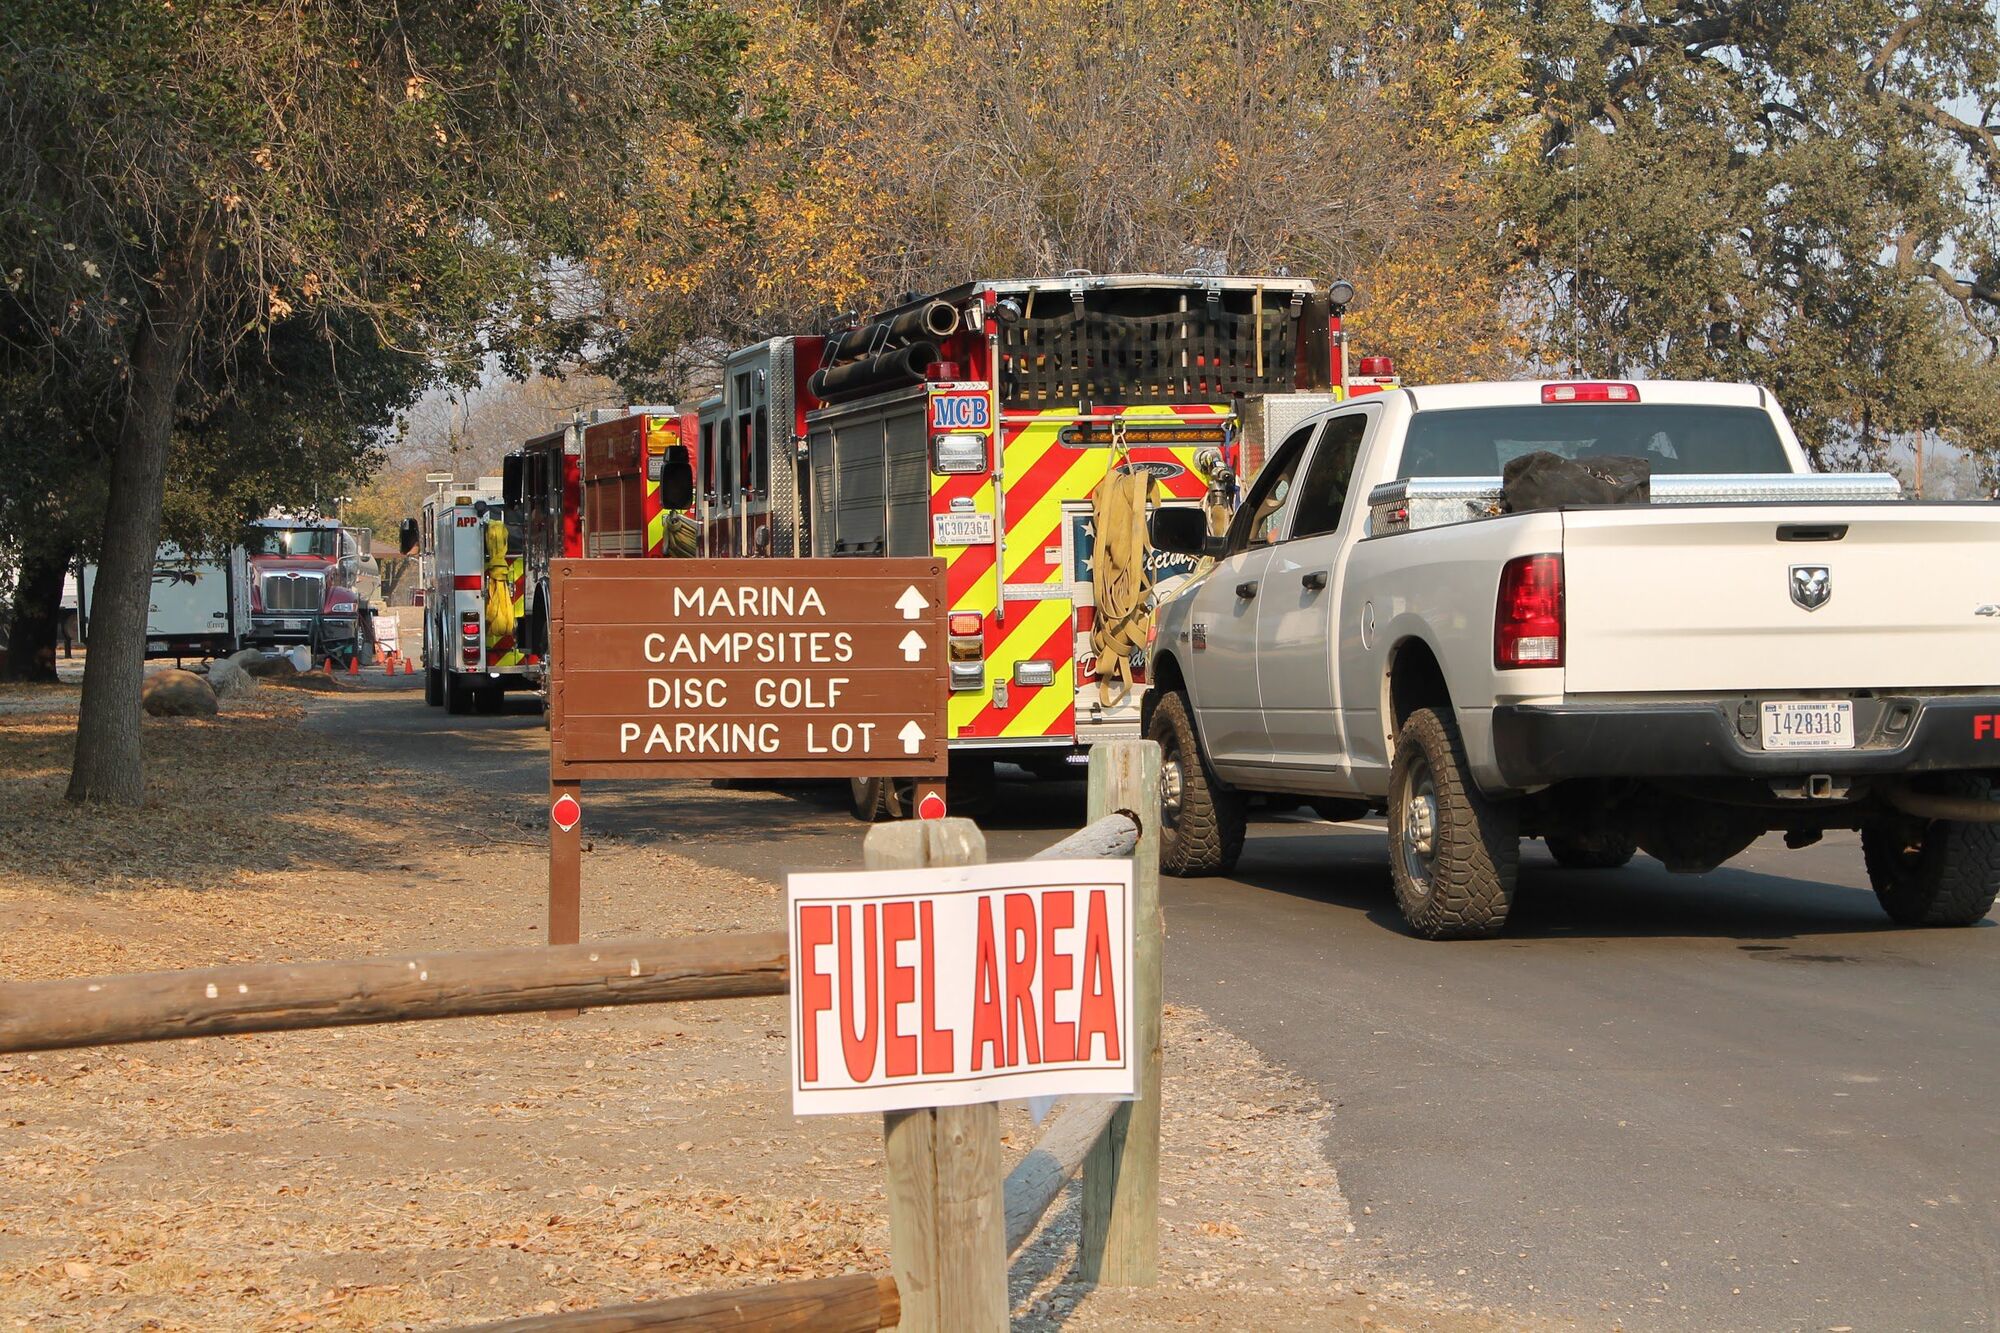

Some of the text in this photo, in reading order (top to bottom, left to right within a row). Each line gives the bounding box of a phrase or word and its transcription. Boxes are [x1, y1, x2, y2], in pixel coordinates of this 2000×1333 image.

[934, 397, 988, 427] MCB
[456, 516, 478, 528] APP
[938, 521, 989, 537] MC302364
[673, 586, 826, 617] MARINA
[644, 632, 853, 663] CAMPSITES
[648, 678, 849, 708] DISC GOLF
[620, 722, 876, 754] PARKING LOT
[1773, 712, 1841, 734] I428318
[800, 889, 1121, 1083] FUEL AREA
